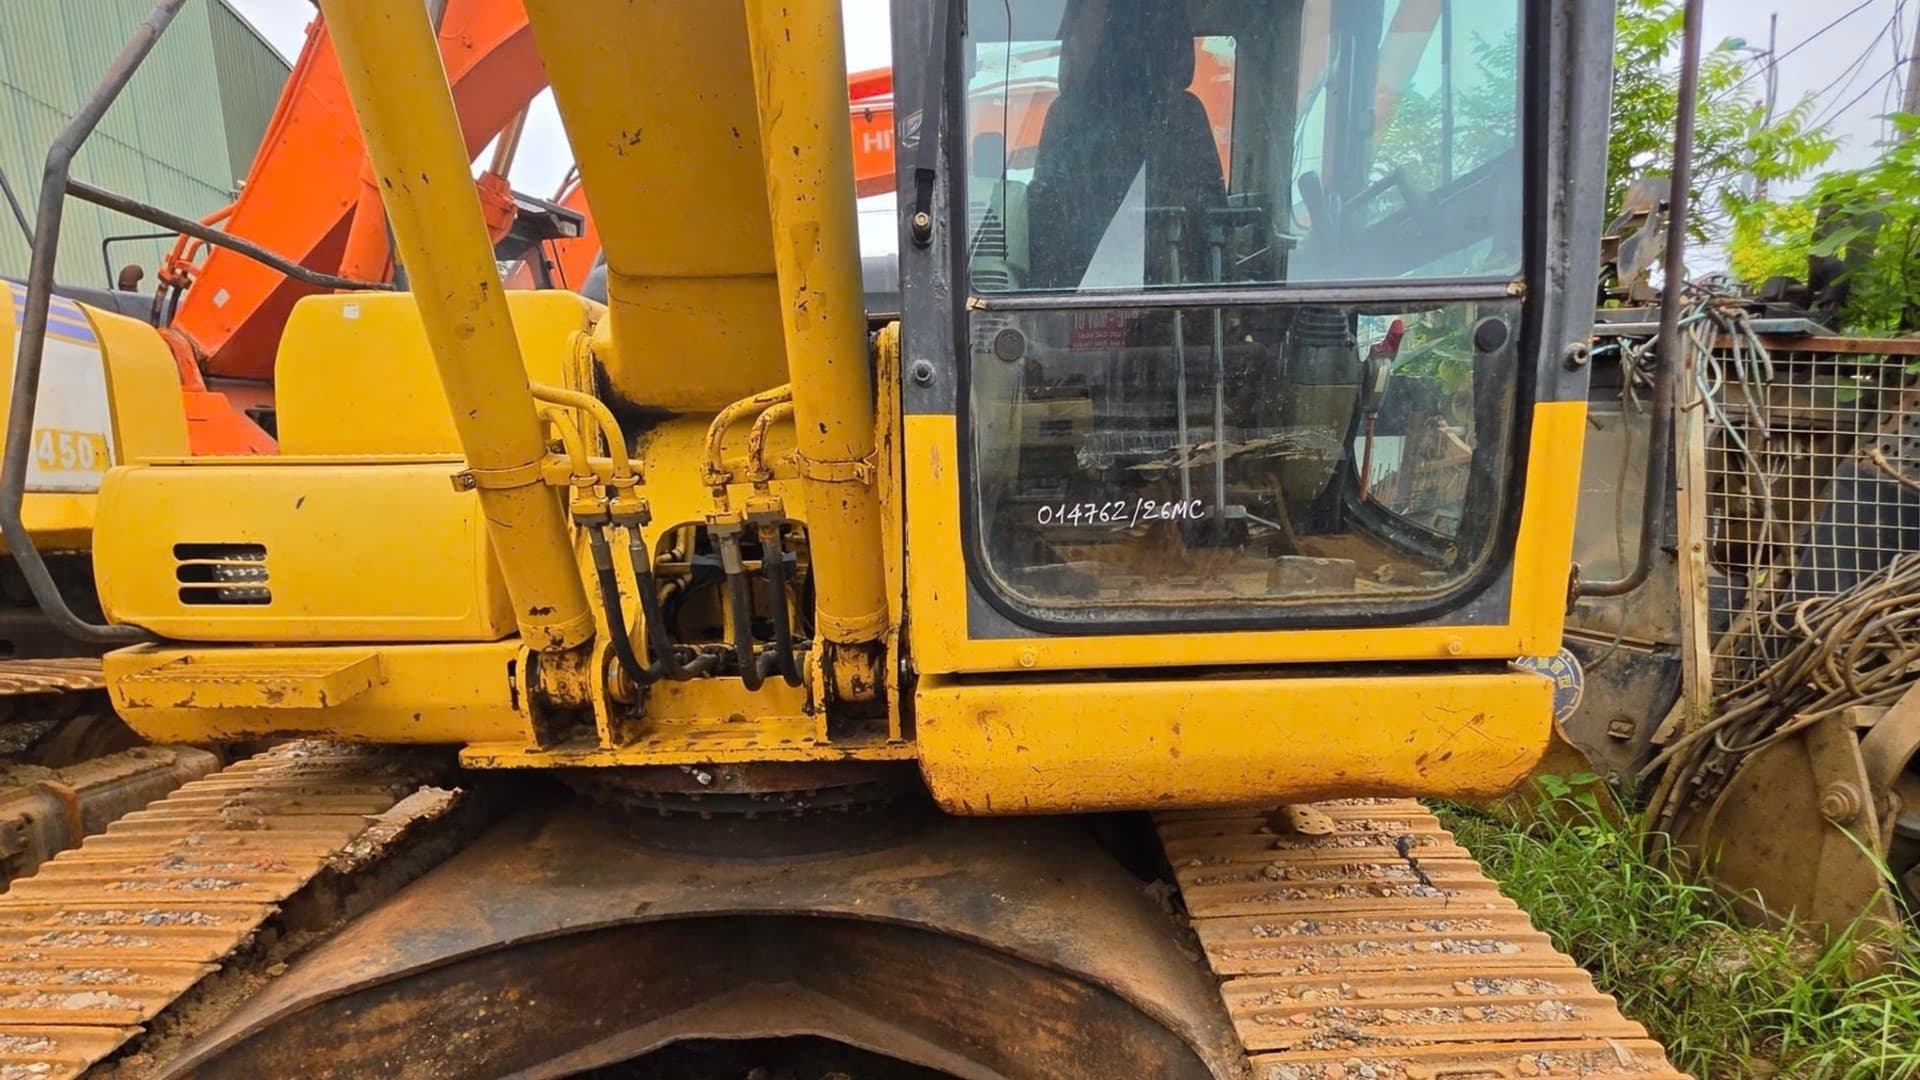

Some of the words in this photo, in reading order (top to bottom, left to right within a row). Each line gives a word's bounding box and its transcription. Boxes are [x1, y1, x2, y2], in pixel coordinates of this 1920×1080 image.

[863, 129, 893, 153] HI
[37, 431, 94, 469] 450
[1037, 498, 1205, 528] 014762/26MC
